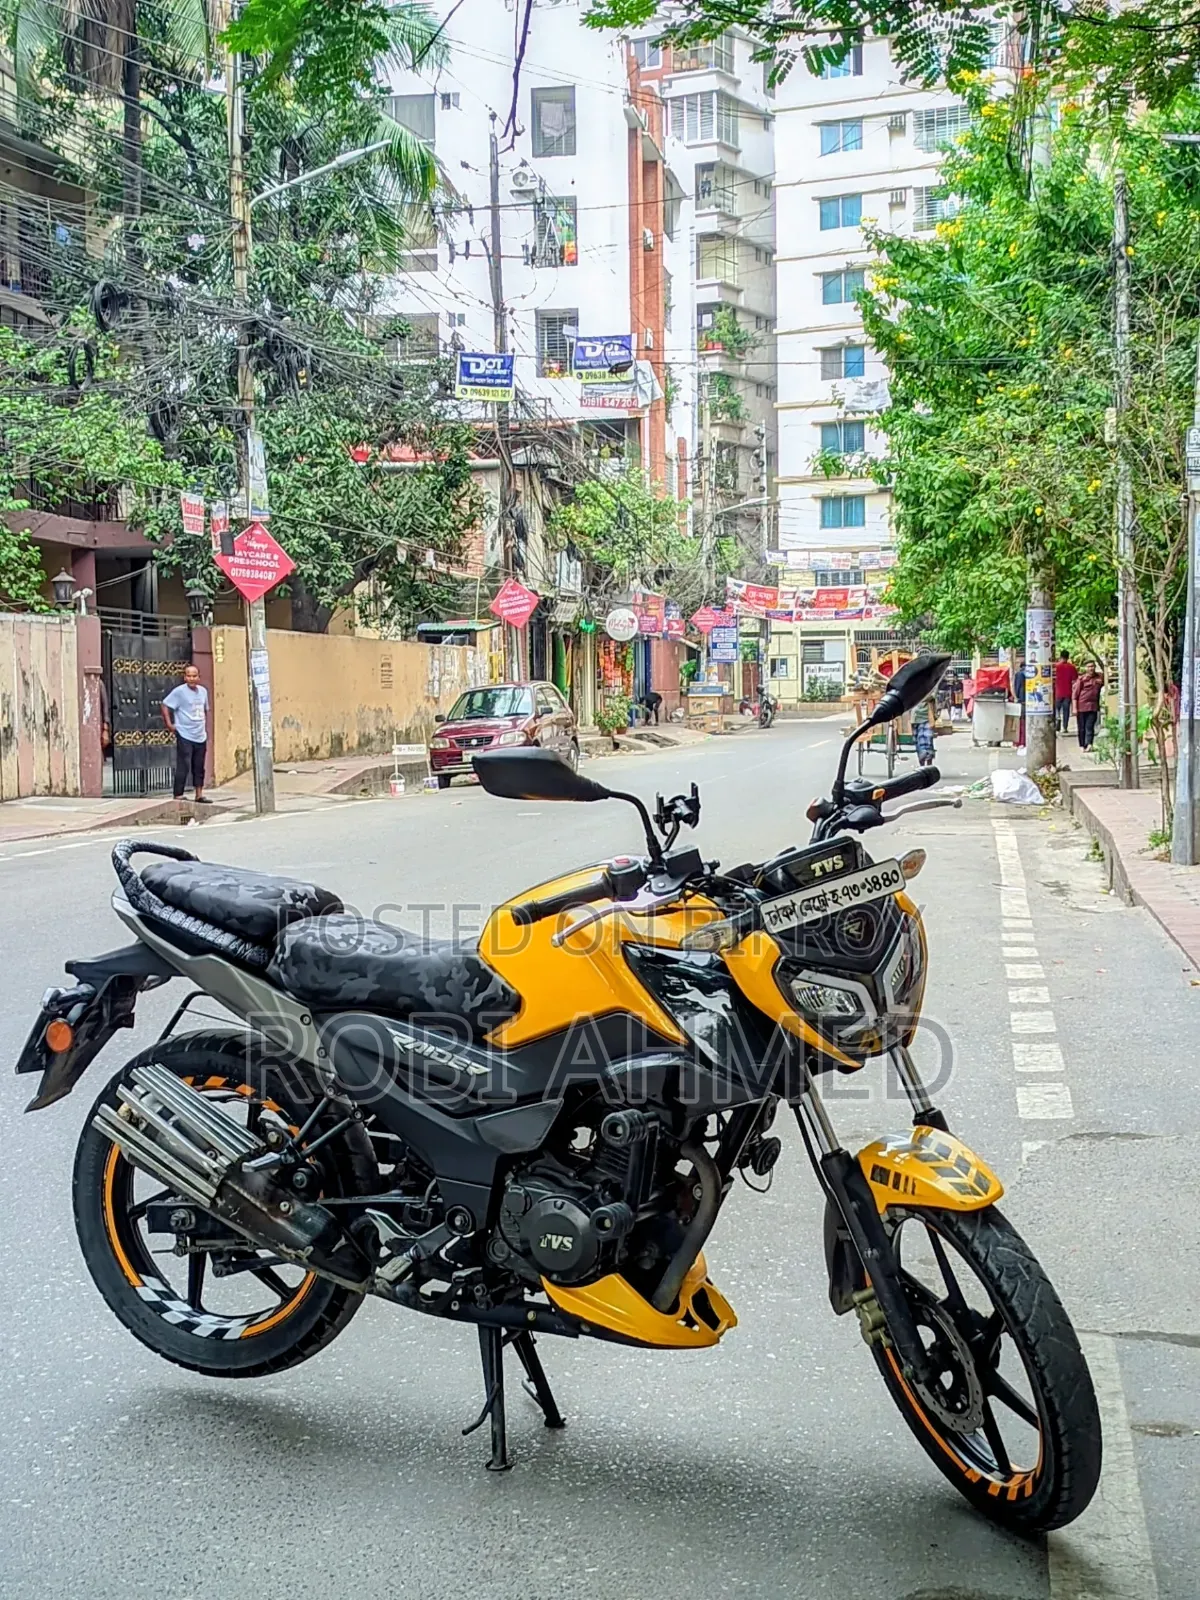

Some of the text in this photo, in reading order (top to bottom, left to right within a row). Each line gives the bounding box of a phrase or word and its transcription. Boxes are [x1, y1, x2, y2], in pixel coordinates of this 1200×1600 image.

[462, 356, 504, 374] DOT
[228, 556, 281, 569] PRESCHOOL
[811, 855, 844, 877] TVS
[385, 1027, 492, 1076] RAIDER
[540, 1233, 574, 1251] TVS
